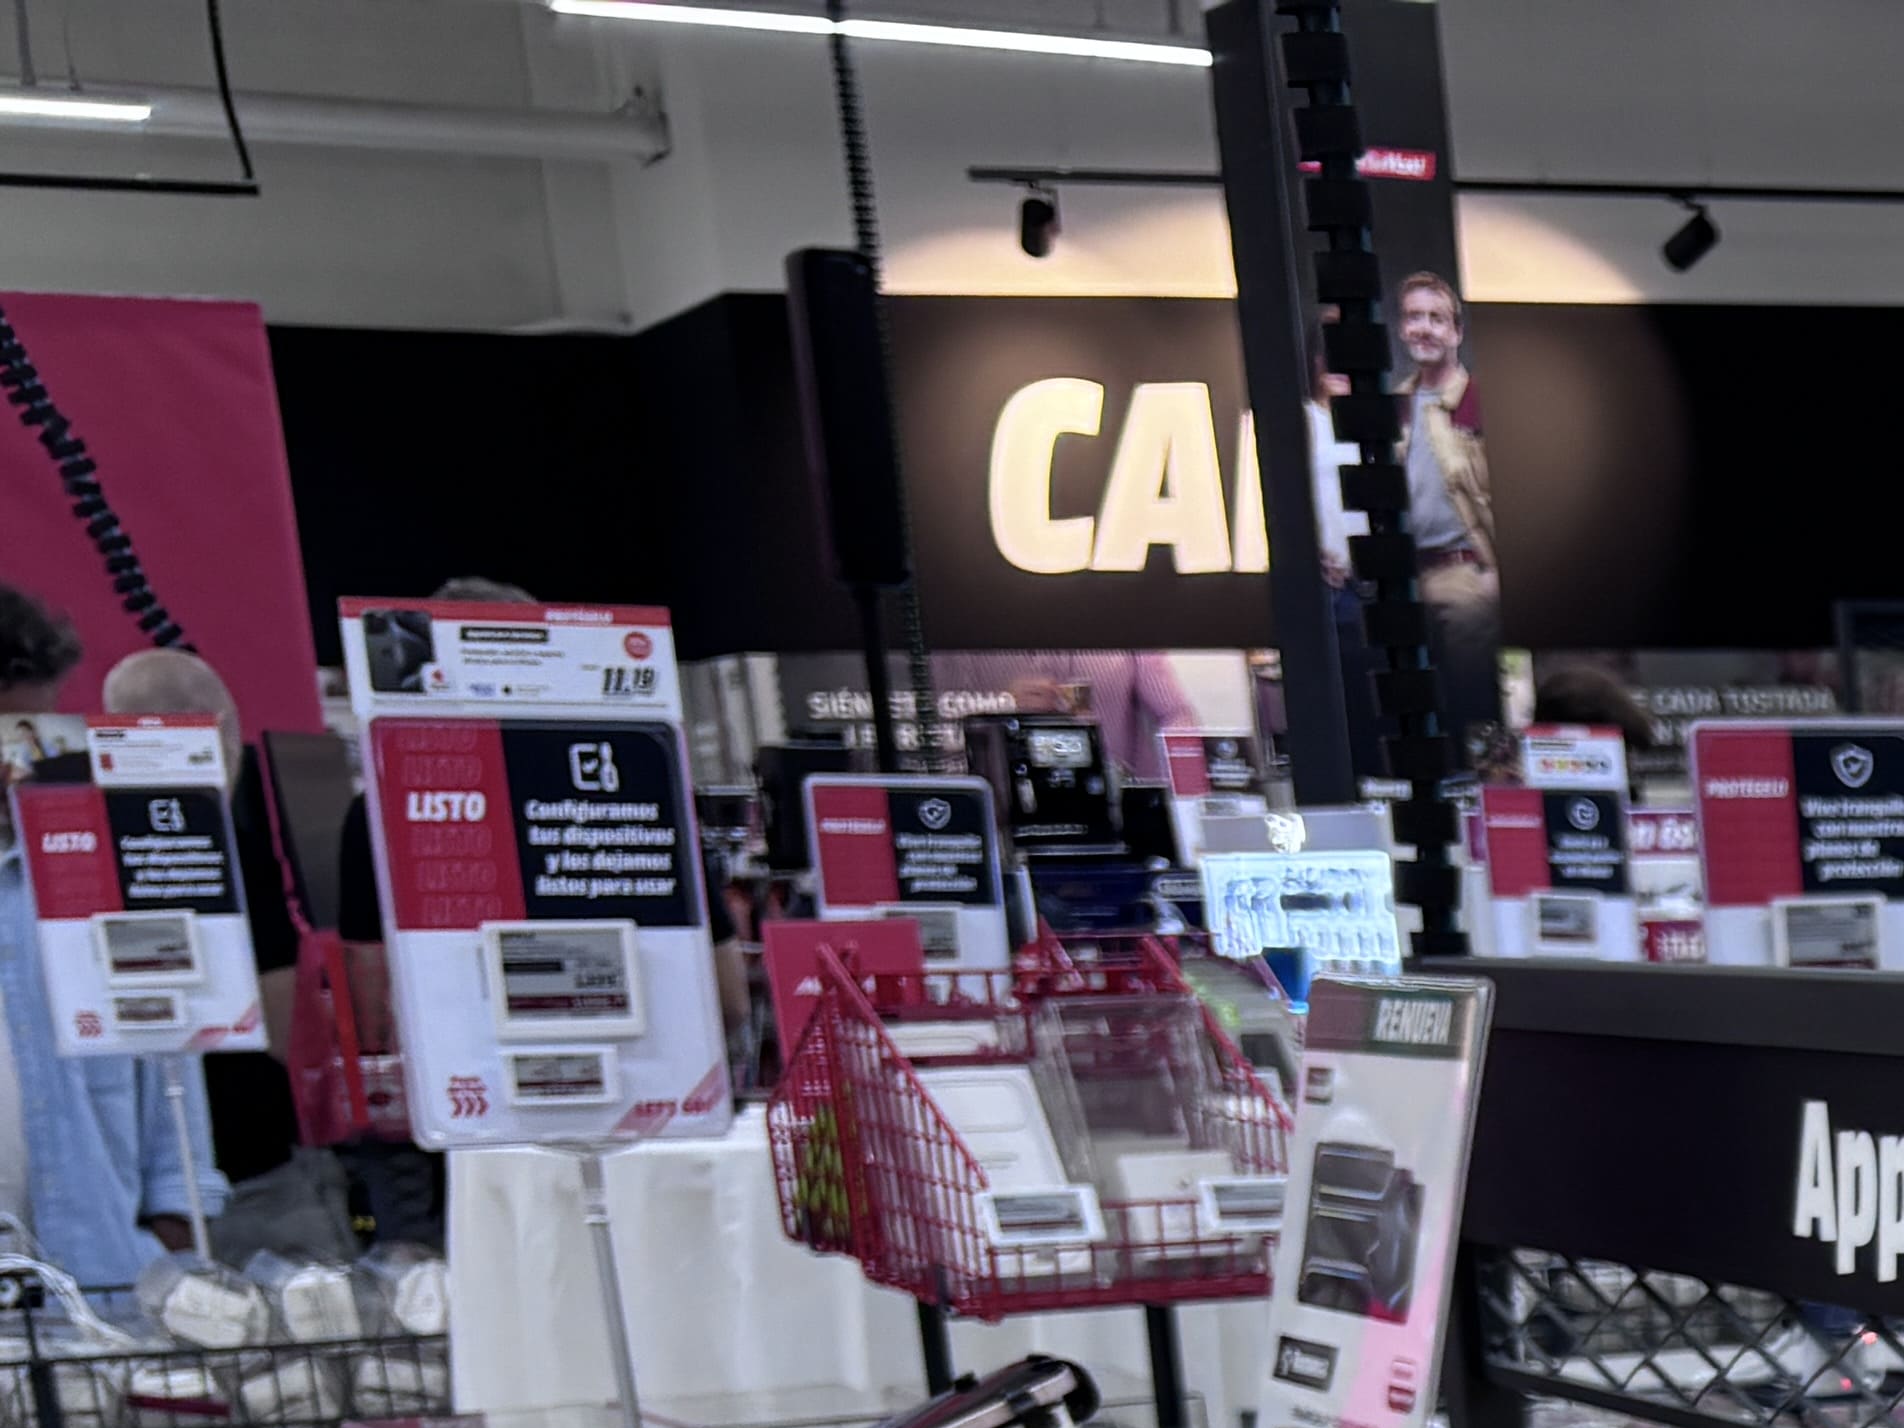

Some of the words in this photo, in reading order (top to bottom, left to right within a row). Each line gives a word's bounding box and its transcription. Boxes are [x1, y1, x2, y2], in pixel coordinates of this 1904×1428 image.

[989, 376, 1270, 575] CA
[407, 792, 486, 822] LISTO
[525, 800, 659, 823] Configuramos
[1374, 998, 1453, 1045] RENUEVA
